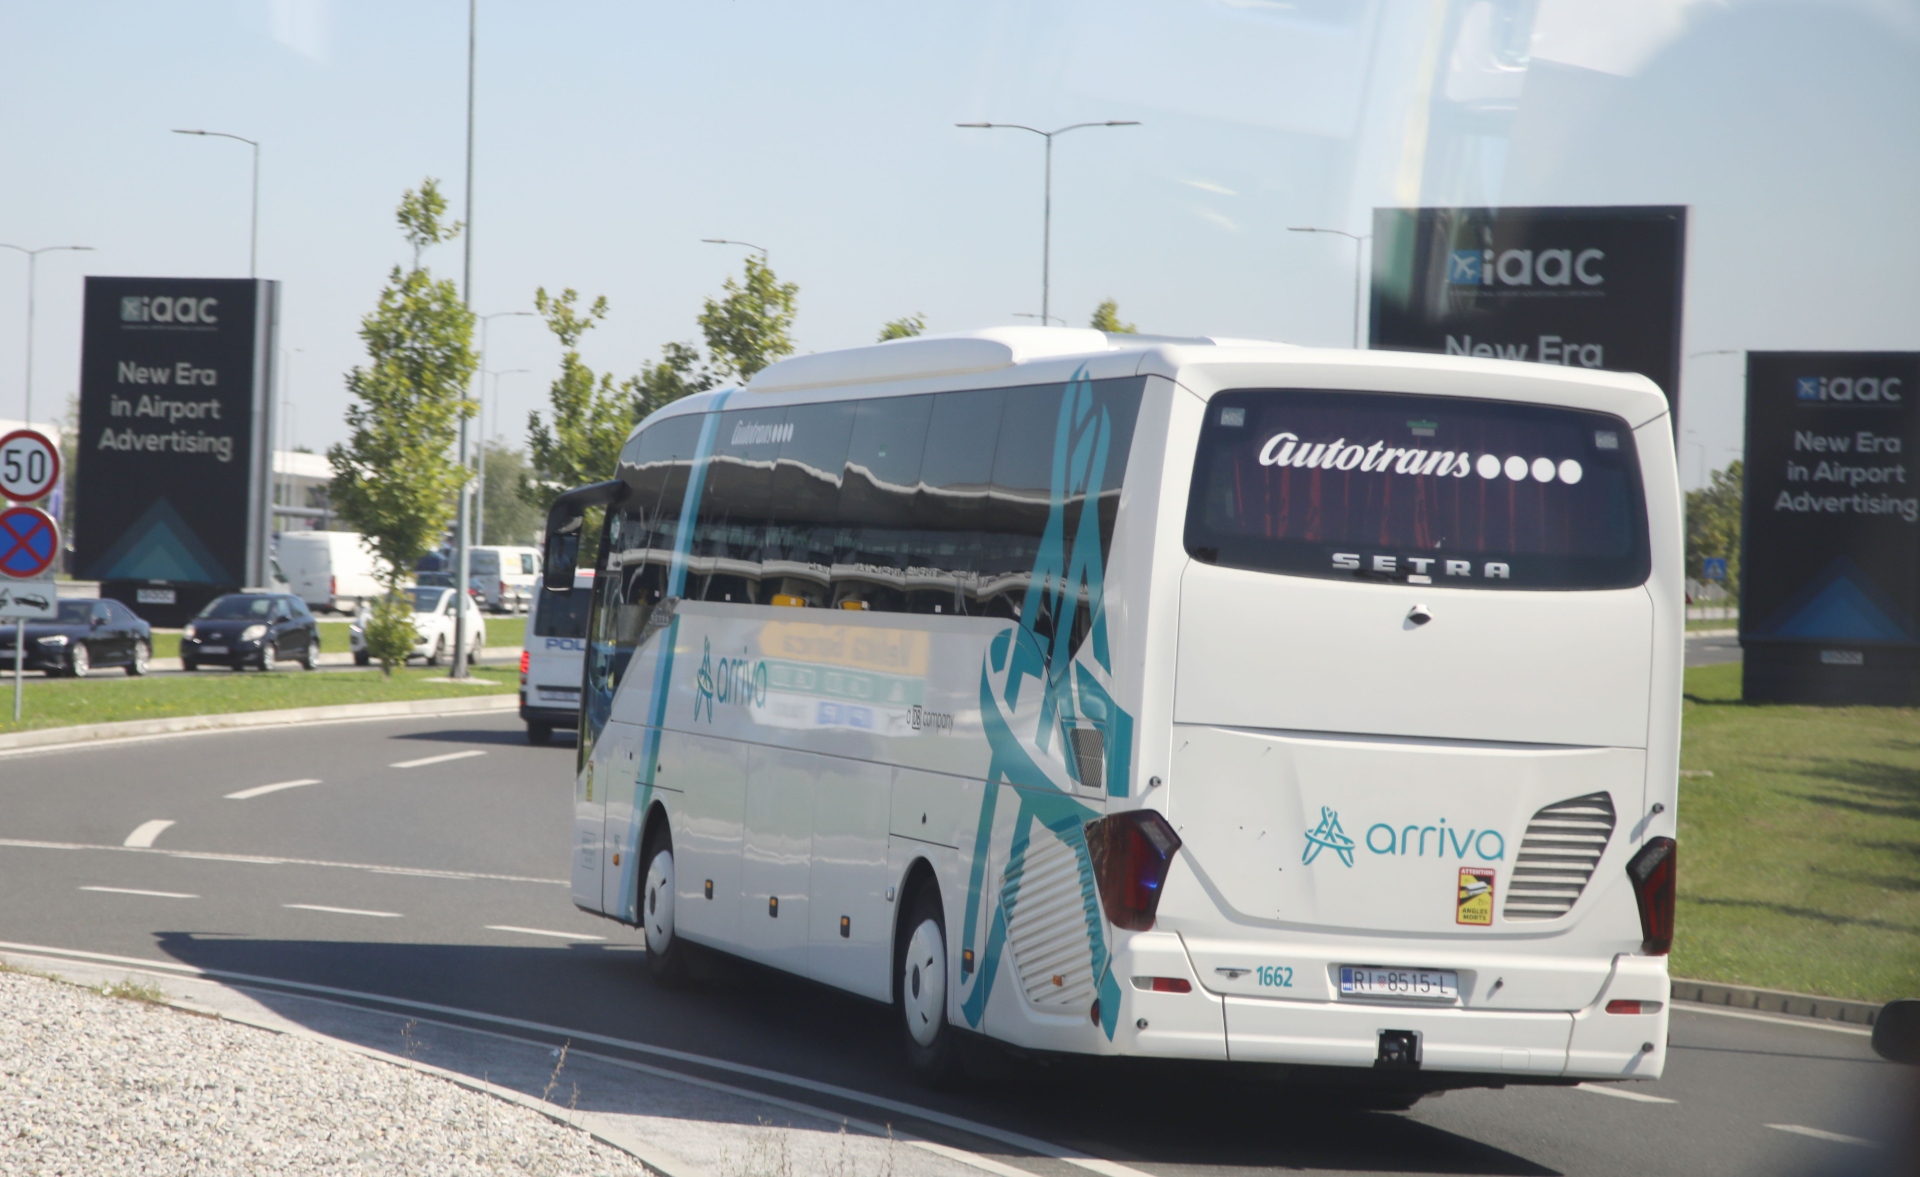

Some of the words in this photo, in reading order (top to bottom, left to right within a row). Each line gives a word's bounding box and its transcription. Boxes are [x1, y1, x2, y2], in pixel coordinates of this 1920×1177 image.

[1482, 248, 1605, 286] iaac
[141, 296, 218, 323] iaac
[1446, 335, 1529, 361] New
[1537, 335, 1603, 368] Era
[118, 361, 171, 385] New
[175, 362, 217, 386] Era
[1819, 376, 1902, 401] iaac
[110, 394, 132, 417] in
[134, 394, 221, 424] Airport
[99, 427, 233, 462] Advertising
[1794, 430, 1850, 452] New
[1856, 431, 1902, 453] Era
[4, 449, 46, 484] 50
[1787, 460, 1809, 481] in
[1812, 460, 1907, 487] Airport
[1774, 490, 1919, 522] Advertising
[1332, 552, 1510, 579] SETRA
[545, 638, 587, 651] POL
[716, 646, 767, 709] arriva
[922, 709, 955, 735] company
[1365, 817, 1505, 861] arriva
[1461, 868, 1494, 876] ATTENTION
[1256, 965, 1293, 988] 1662
[1354, 971, 1373, 990] RI
[1388, 972, 1449, 994] 8515-L
